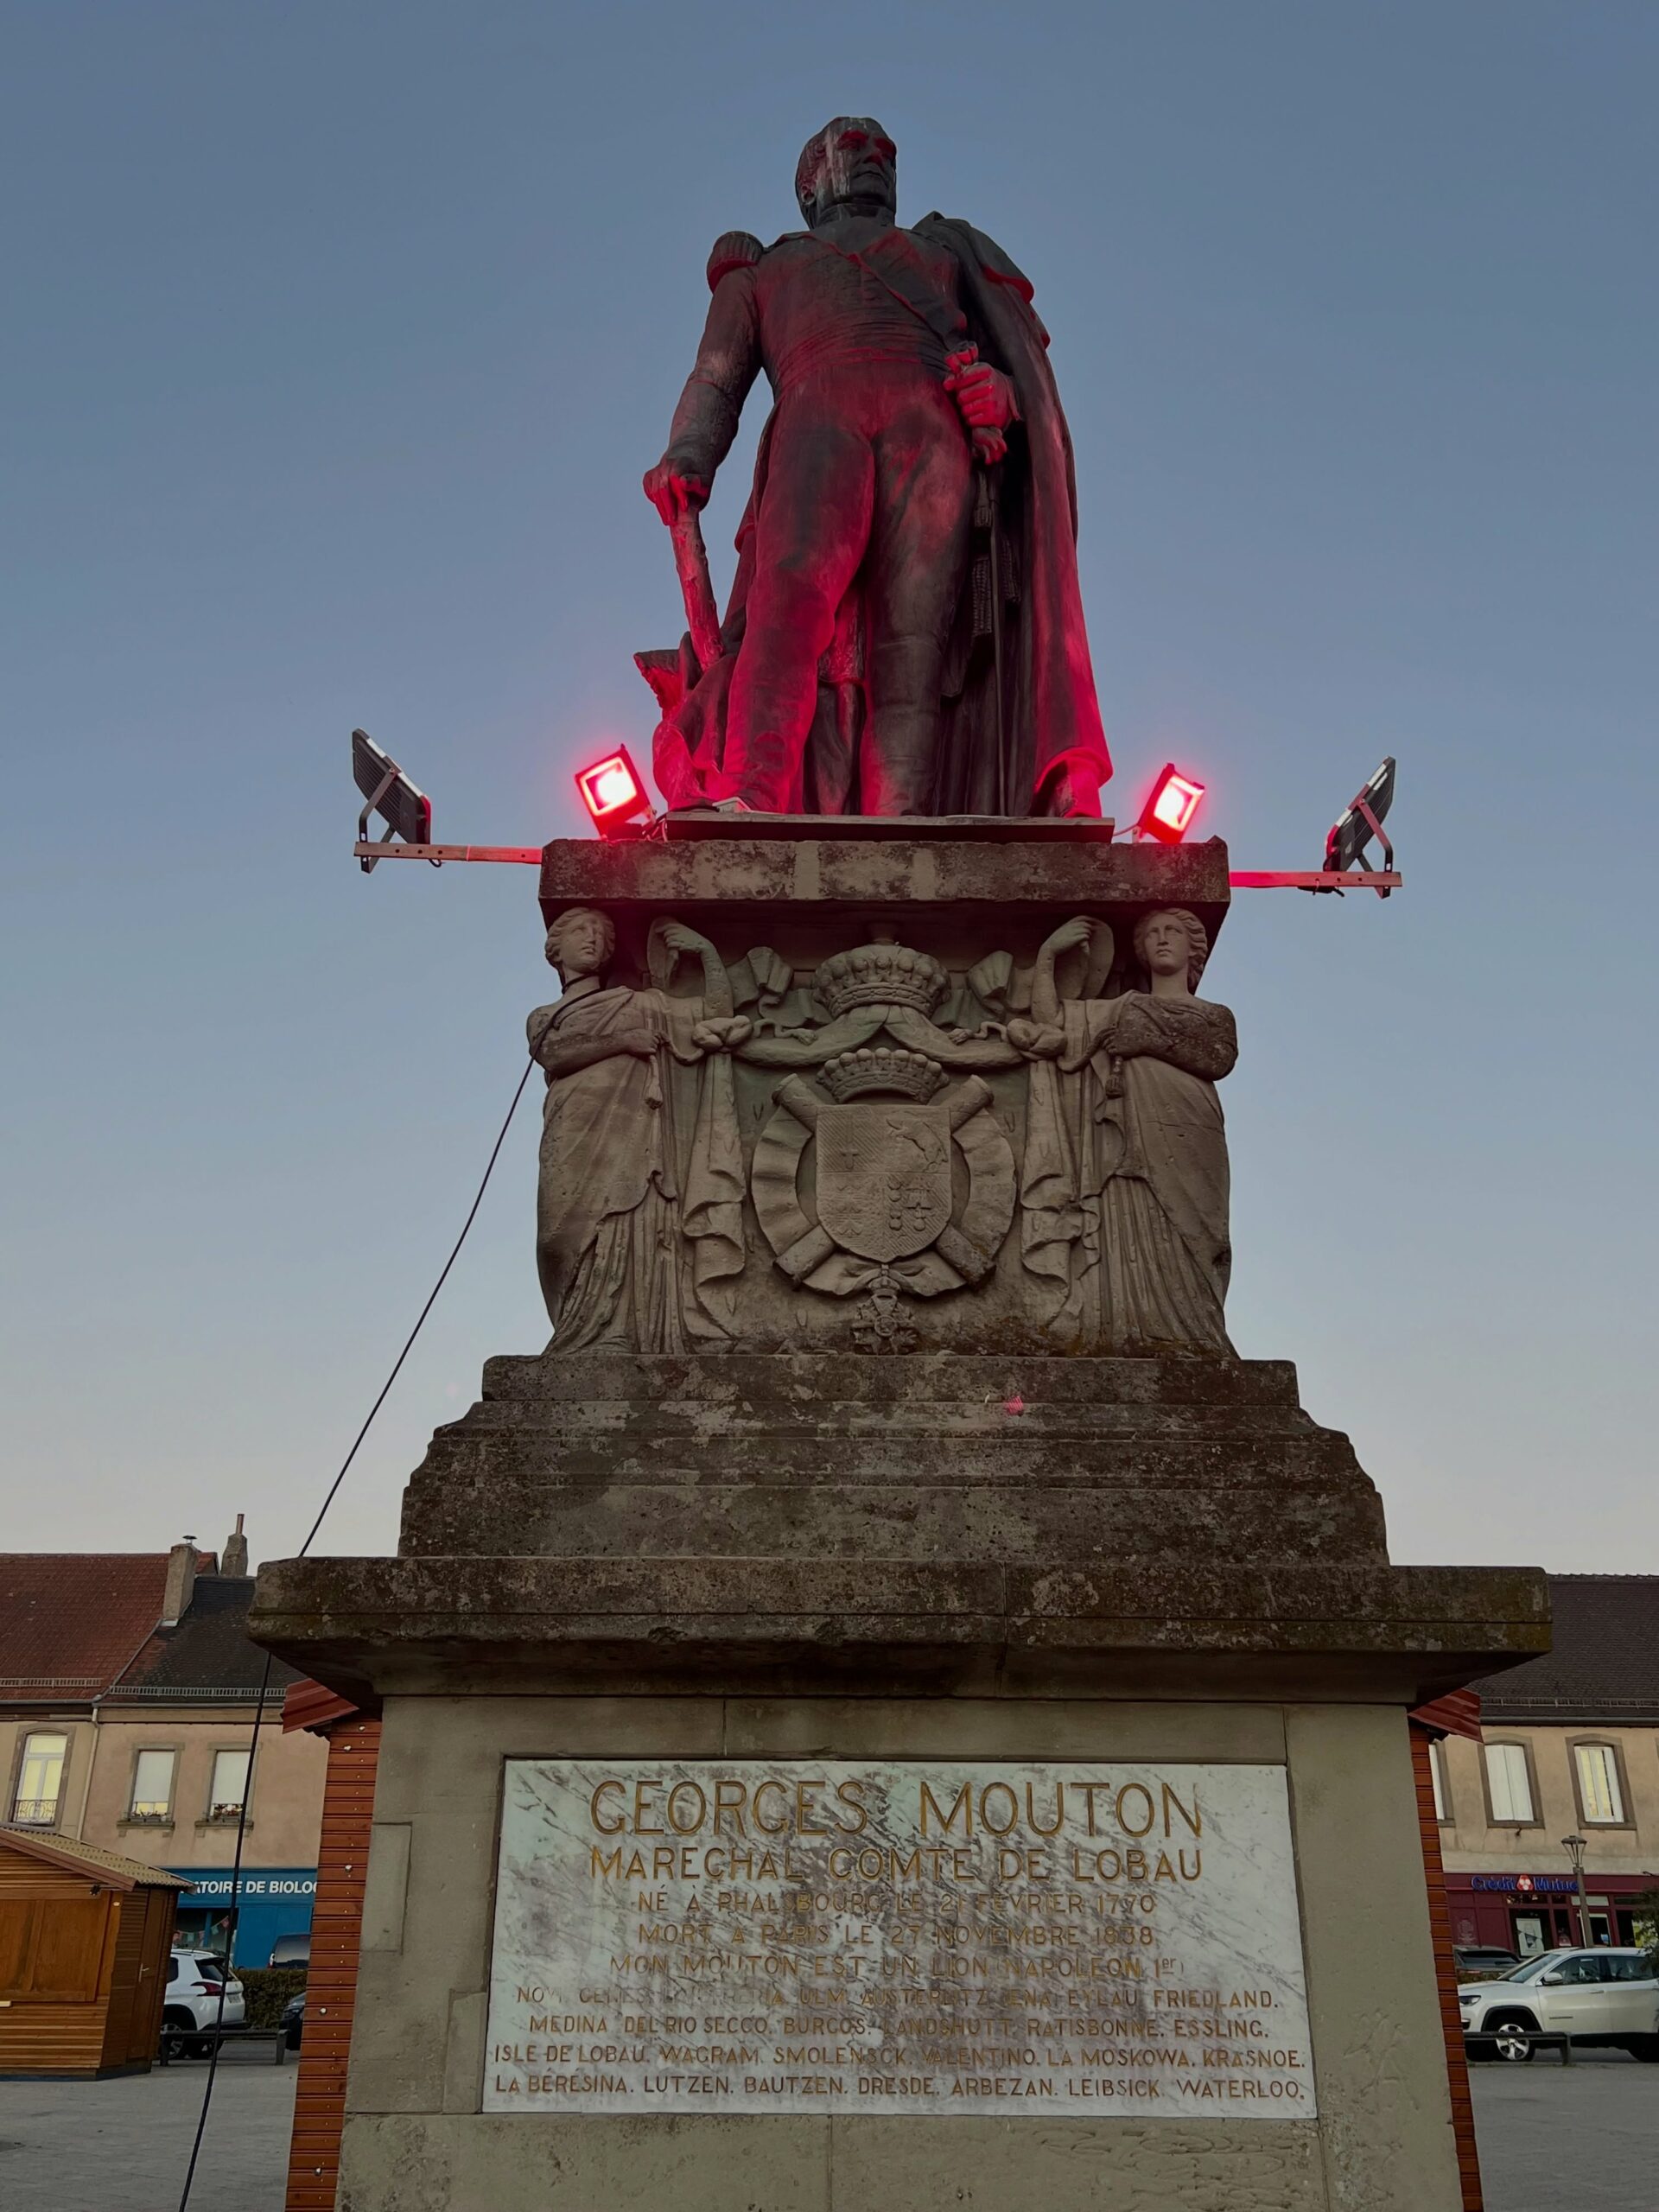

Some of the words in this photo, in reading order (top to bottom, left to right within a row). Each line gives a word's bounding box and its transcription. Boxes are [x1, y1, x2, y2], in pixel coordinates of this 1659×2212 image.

[590, 1780, 868, 1835] GEORGES
[920, 1781, 1202, 1838] MOUTON
[590, 1847, 803, 1880] MARECHAL
[829, 1847, 976, 1881] COMTE
[999, 1848, 1050, 1882] DE
[1074, 1848, 1201, 1882] LOBAU
[245, 1881, 265, 1894] DE
[639, 1884, 670, 1911] NÉ
[718, 1891, 882, 1913] PHALSBOURG
[896, 1893, 923, 1913] LE
[977, 1893, 1084, 1914] FEVRIER
[1098, 1893, 1156, 1915] 1770
[639, 1923, 713, 1943] MORT
[761, 1924, 829, 1944] PARIS
[845, 1924, 876, 1944] LE
[891, 1925, 920, 1945] 27
[935, 1925, 1080, 1946] NOVEMBRE
[1095, 1926, 1154, 1947] 1838
[610, 1955, 670, 1976] MON
[683, 1955, 798, 1977] MOUTON
[814, 1955, 866, 1977] EST
[881, 1956, 917, 1977] UN
[932, 1956, 988, 1977] LION
[1068, 1990, 1138, 2008] EYLAU
[1154, 1990, 1279, 2009] FRIEDLAND.
[530, 2015, 607, 2033] MEDINA
[624, 2016, 658, 2033] DEL
[664, 2016, 697, 2033] RIO
[703, 2017, 772, 2035] SECCO.
[783, 2017, 871, 2036] BURGOS.
[1027, 2018, 1165, 2037] RATISBONNE.
[1174, 2019, 1268, 2038] ESSLING.
[495, 2044, 537, 2063] ISLE
[546, 2045, 571, 2063] DE
[1048, 2049, 1073, 2067] LA
[1082, 2049, 1196, 2068] MOSKOWA.
[1203, 2050, 1306, 2069] KRASNOE.
[496, 2075, 519, 2092] LA
[528, 2067, 633, 2093] BÉRÉSINA.
[644, 2075, 734, 2094] LUTZEN.
[744, 2076, 849, 2094] BAUTZEN.
[858, 2077, 940, 2095] DRESDE.
[951, 2078, 1058, 2097] ARBEZAN.
[1176, 2079, 1305, 2100] WATERLOO.
